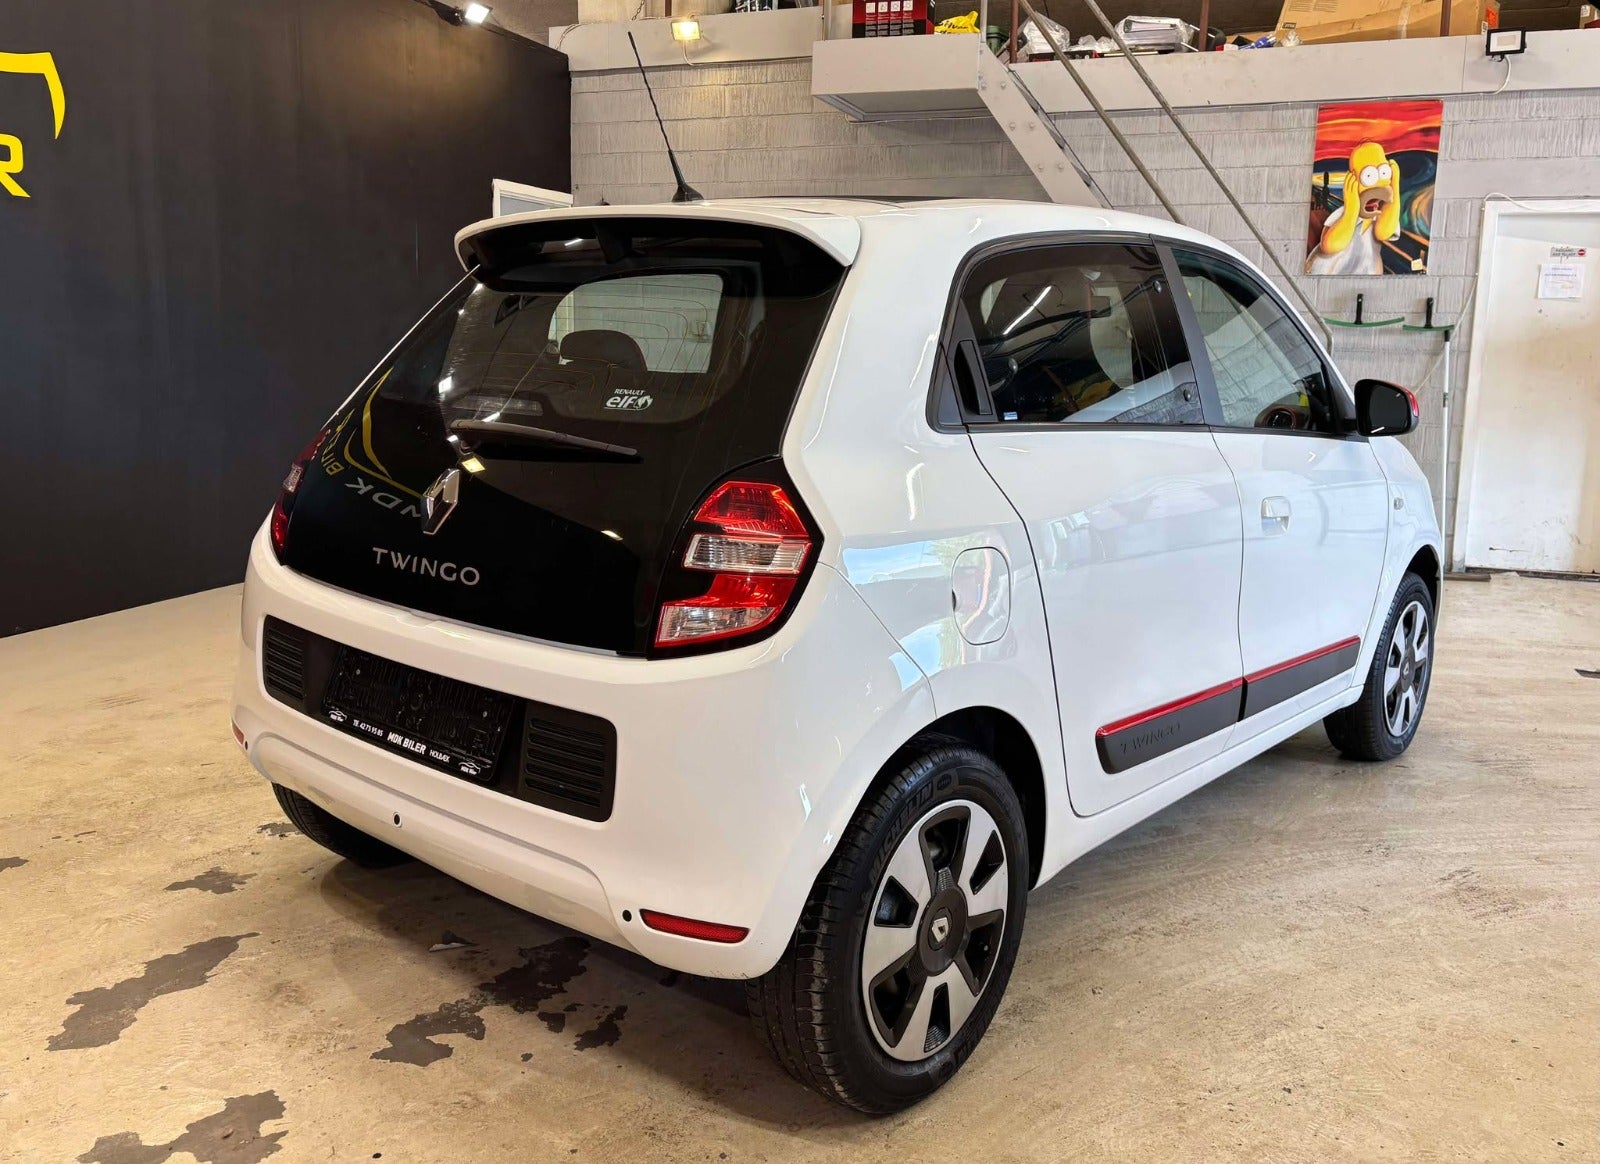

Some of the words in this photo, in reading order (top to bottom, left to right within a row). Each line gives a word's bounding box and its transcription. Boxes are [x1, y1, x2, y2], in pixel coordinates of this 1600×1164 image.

[614, 388, 646, 396] RENAULT
[605, 395, 638, 408] elf
[372, 546, 480, 586] TWINGO
[387, 731, 404, 746] MDK
[402, 737, 427, 755] BILER
